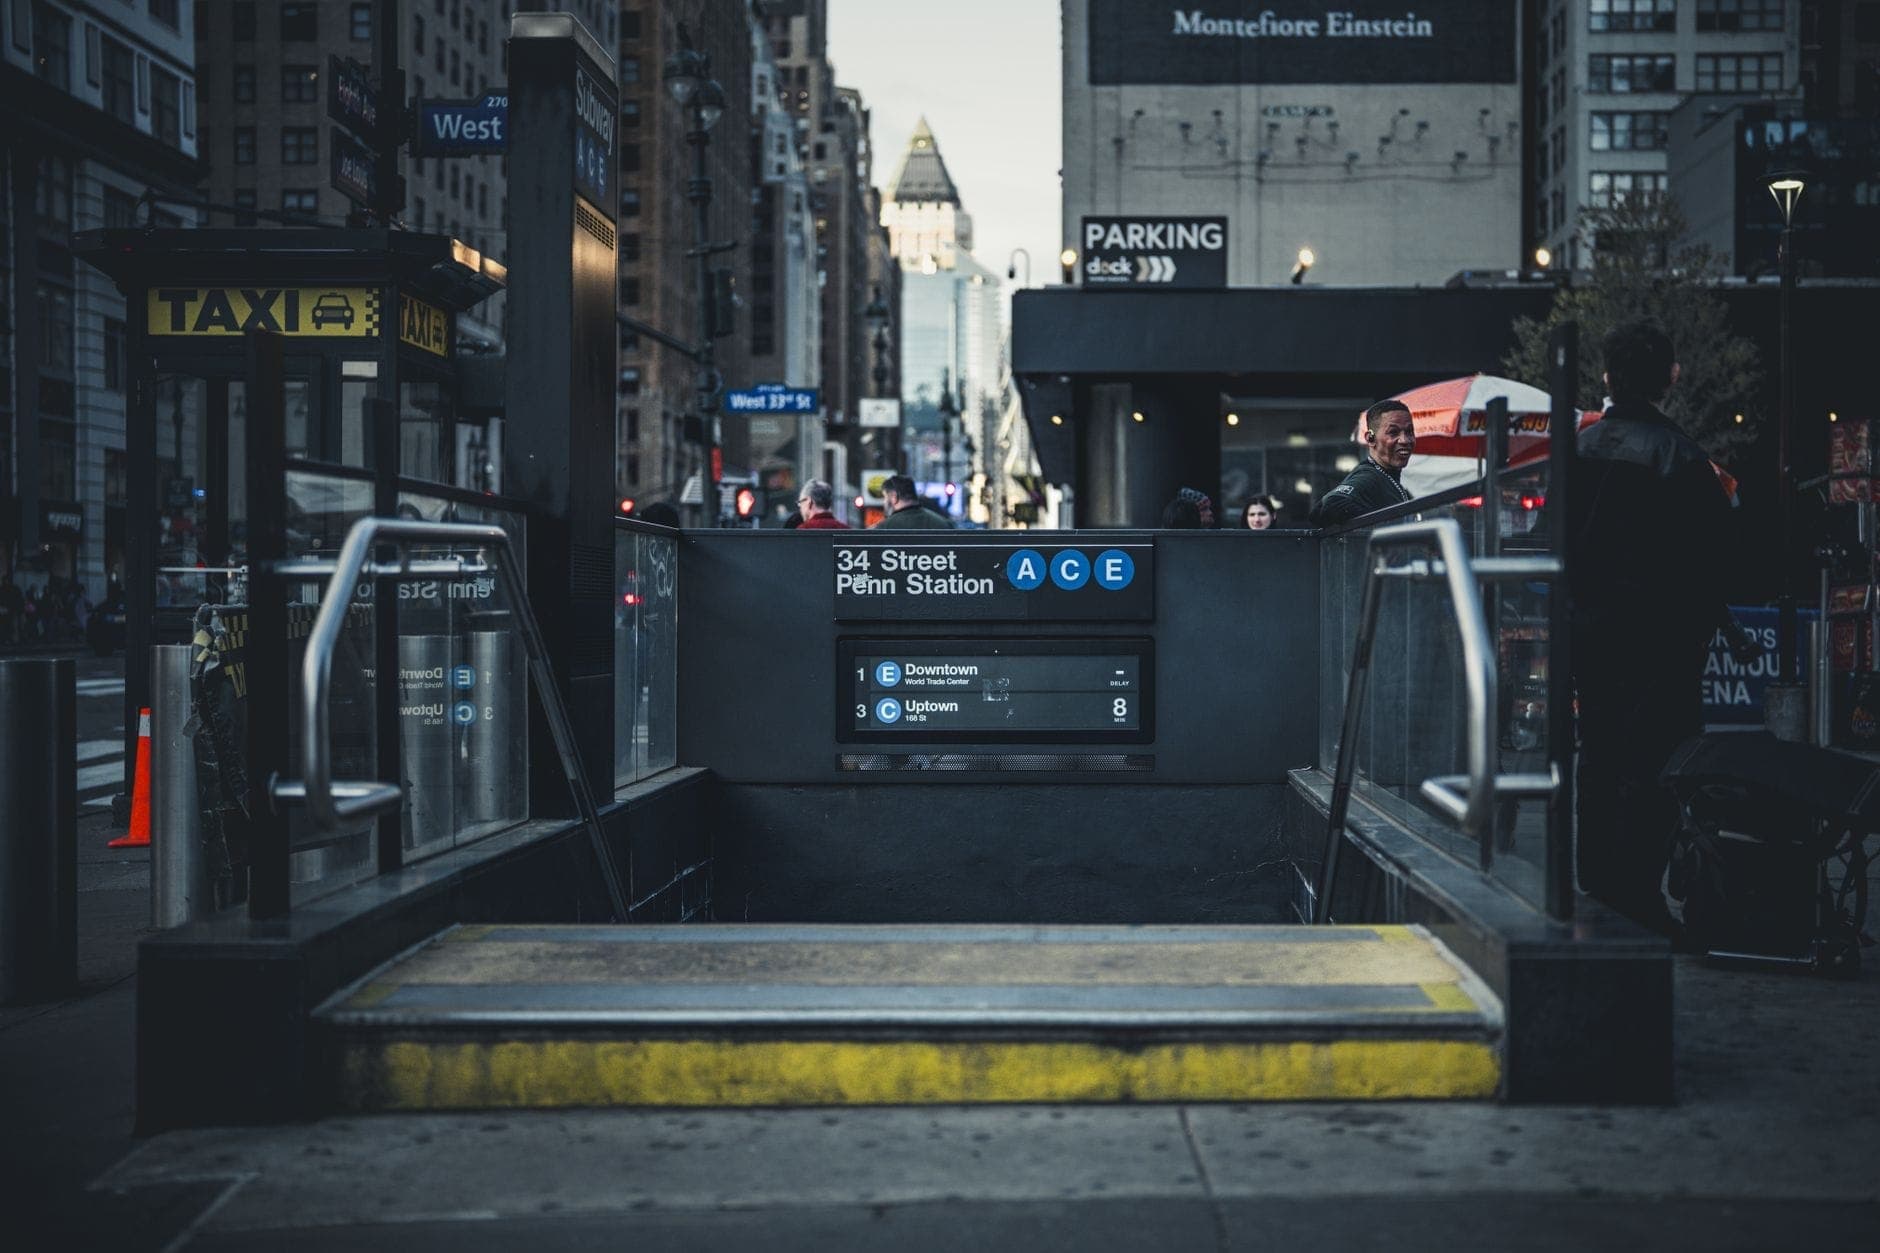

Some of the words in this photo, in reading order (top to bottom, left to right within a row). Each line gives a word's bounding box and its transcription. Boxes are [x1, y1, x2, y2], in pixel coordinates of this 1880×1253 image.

[1173, 10, 1321, 37] Montefiore
[1326, 12, 1434, 37] Einstein
[576, 68, 614, 156] Subway
[433, 113, 502, 140] West
[577, 136, 584, 168] A
[588, 147, 595, 177] C
[599, 155, 605, 186] E
[1086, 222, 1224, 250] PARKING
[158, 289, 299, 332] TAXI
[400, 294, 431, 348] TAXI
[730, 393, 766, 410] West
[837, 549, 870, 571] 34
[881, 549, 958, 571] Street
[1016, 557, 1037, 580] A
[1060, 559, 1080, 581] C
[1105, 558, 1123, 582] E
[836, 573, 896, 595] Penn
[906, 573, 993, 595] Station
[857, 667, 865, 682] 1
[882, 666, 895, 682] E
[905, 663, 978, 676] Downtown
[856, 704, 867, 718] 3
[881, 702, 897, 718] C
[905, 700, 958, 714] Uptown
[919, 714, 927, 722] St
[1112, 697, 1127, 716] 8
